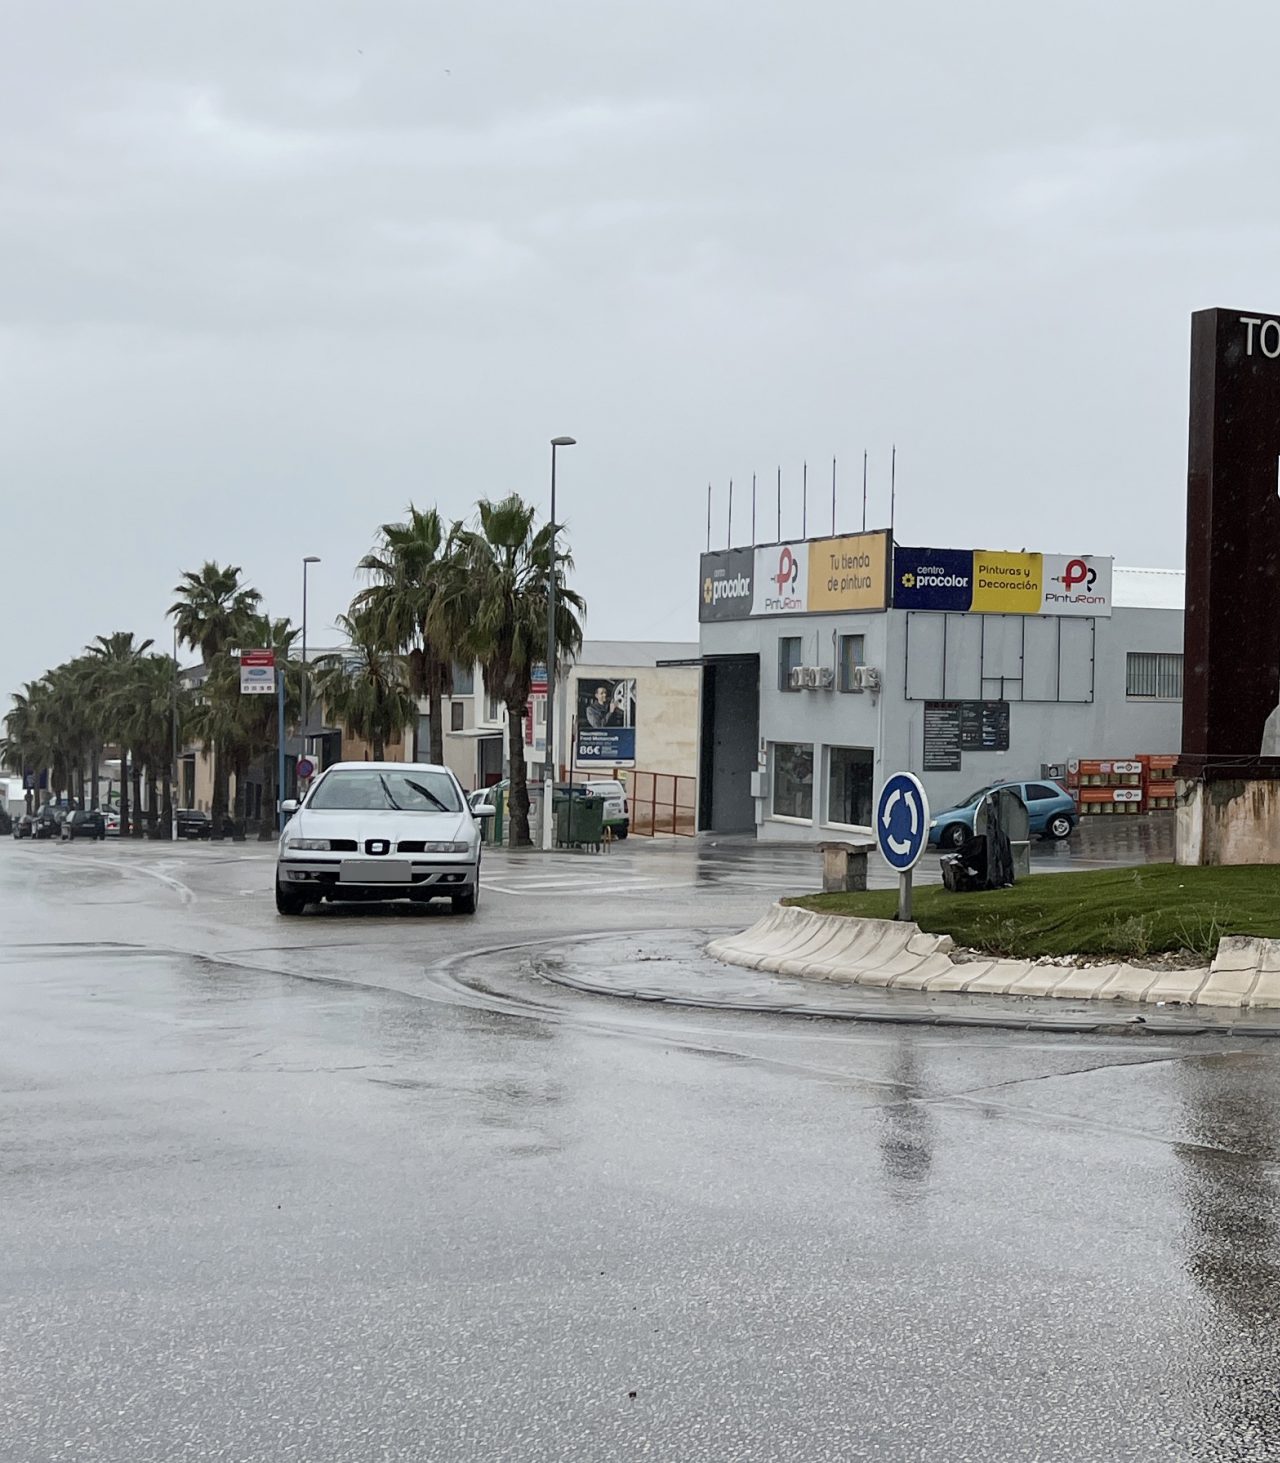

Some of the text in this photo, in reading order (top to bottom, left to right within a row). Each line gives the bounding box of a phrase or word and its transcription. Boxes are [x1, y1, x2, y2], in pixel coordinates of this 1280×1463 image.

[830, 552, 870, 571] Tu tienda
[917, 566, 945, 575] centro
[979, 565, 1031, 578] Pinturas y
[827, 575, 872, 594] de pintura
[916, 574, 969, 590] procolor
[979, 580, 1038, 592] Decoración
[712, 572, 751, 606] procolor
[1045, 593, 1105, 604] PintuRom
[579, 745, 601, 755] 86€
